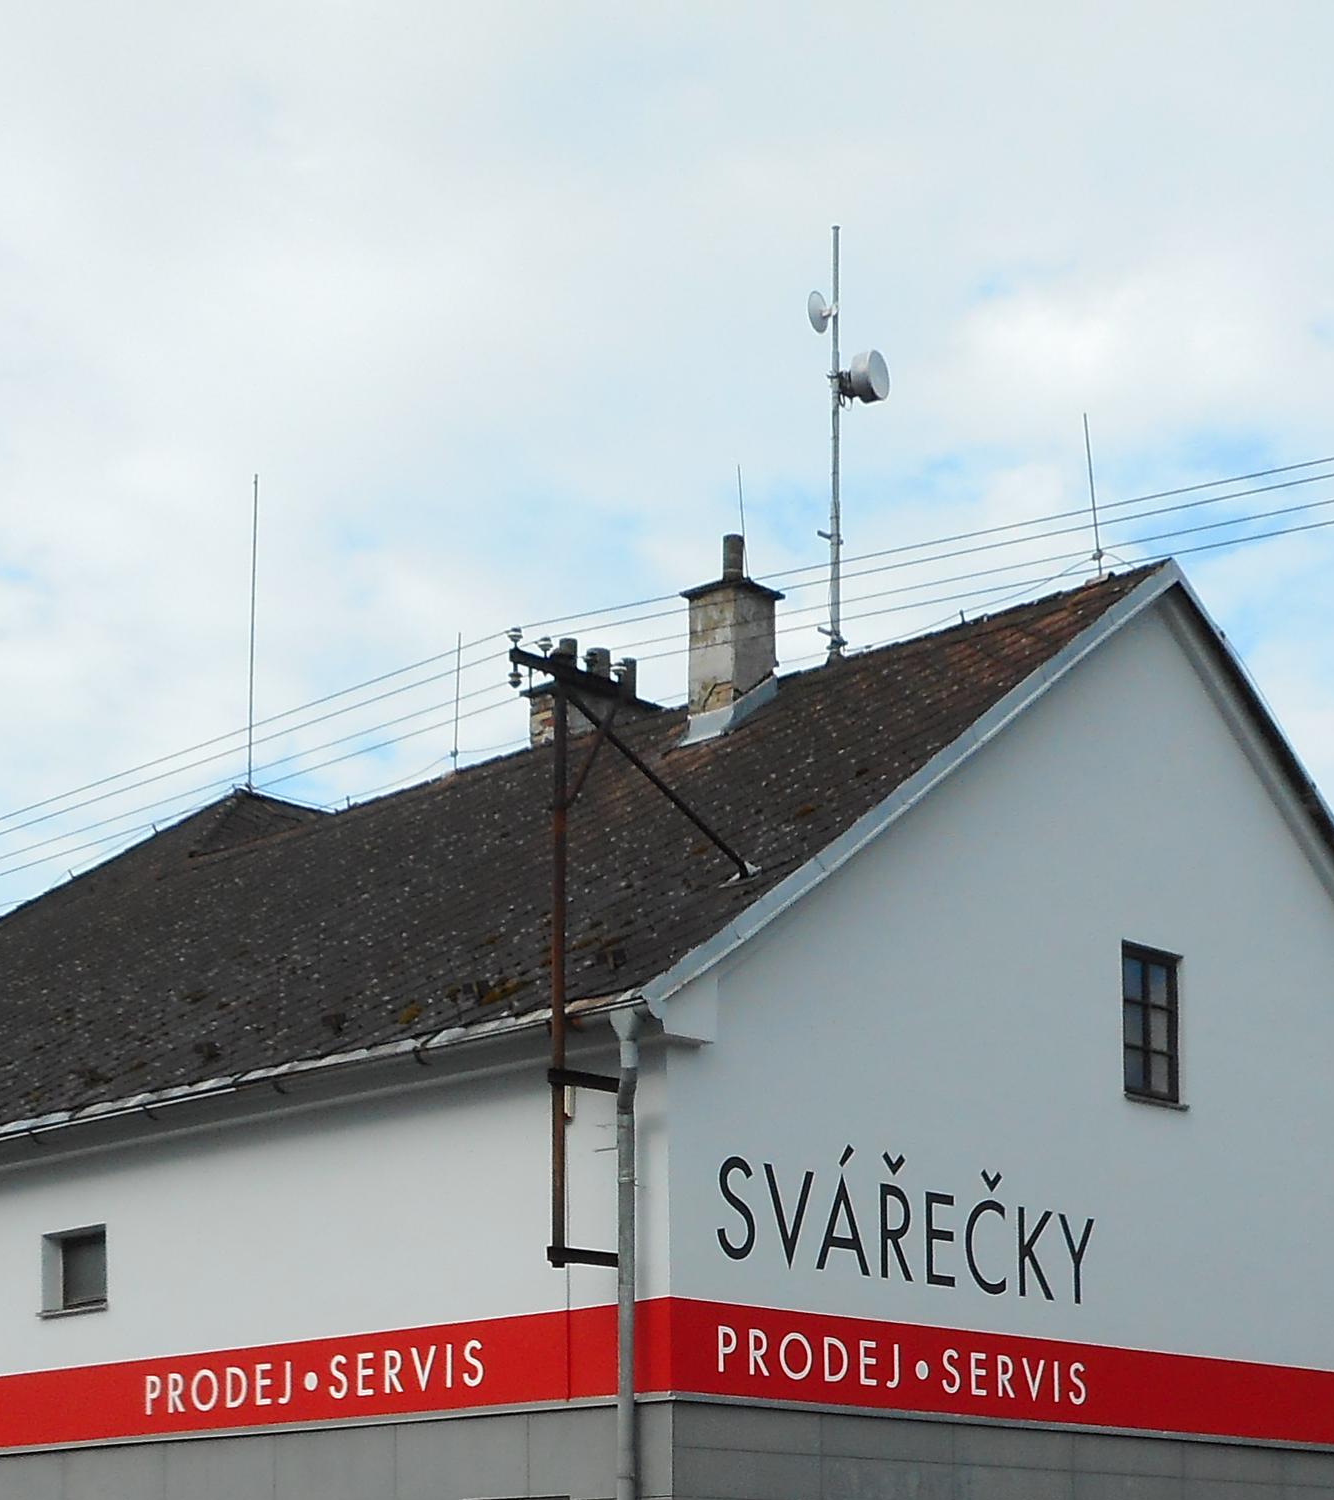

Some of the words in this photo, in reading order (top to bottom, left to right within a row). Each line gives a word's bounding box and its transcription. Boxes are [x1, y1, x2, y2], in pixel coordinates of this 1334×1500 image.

[716, 1144, 1095, 1305] SVÁŘEČKY
[144, 1360, 292, 1416] PRODEJ
[328, 1338, 485, 1399] SERVIS
[717, 1324, 901, 1390] PRODEJ
[941, 1347, 1088, 1406] SERVIS
